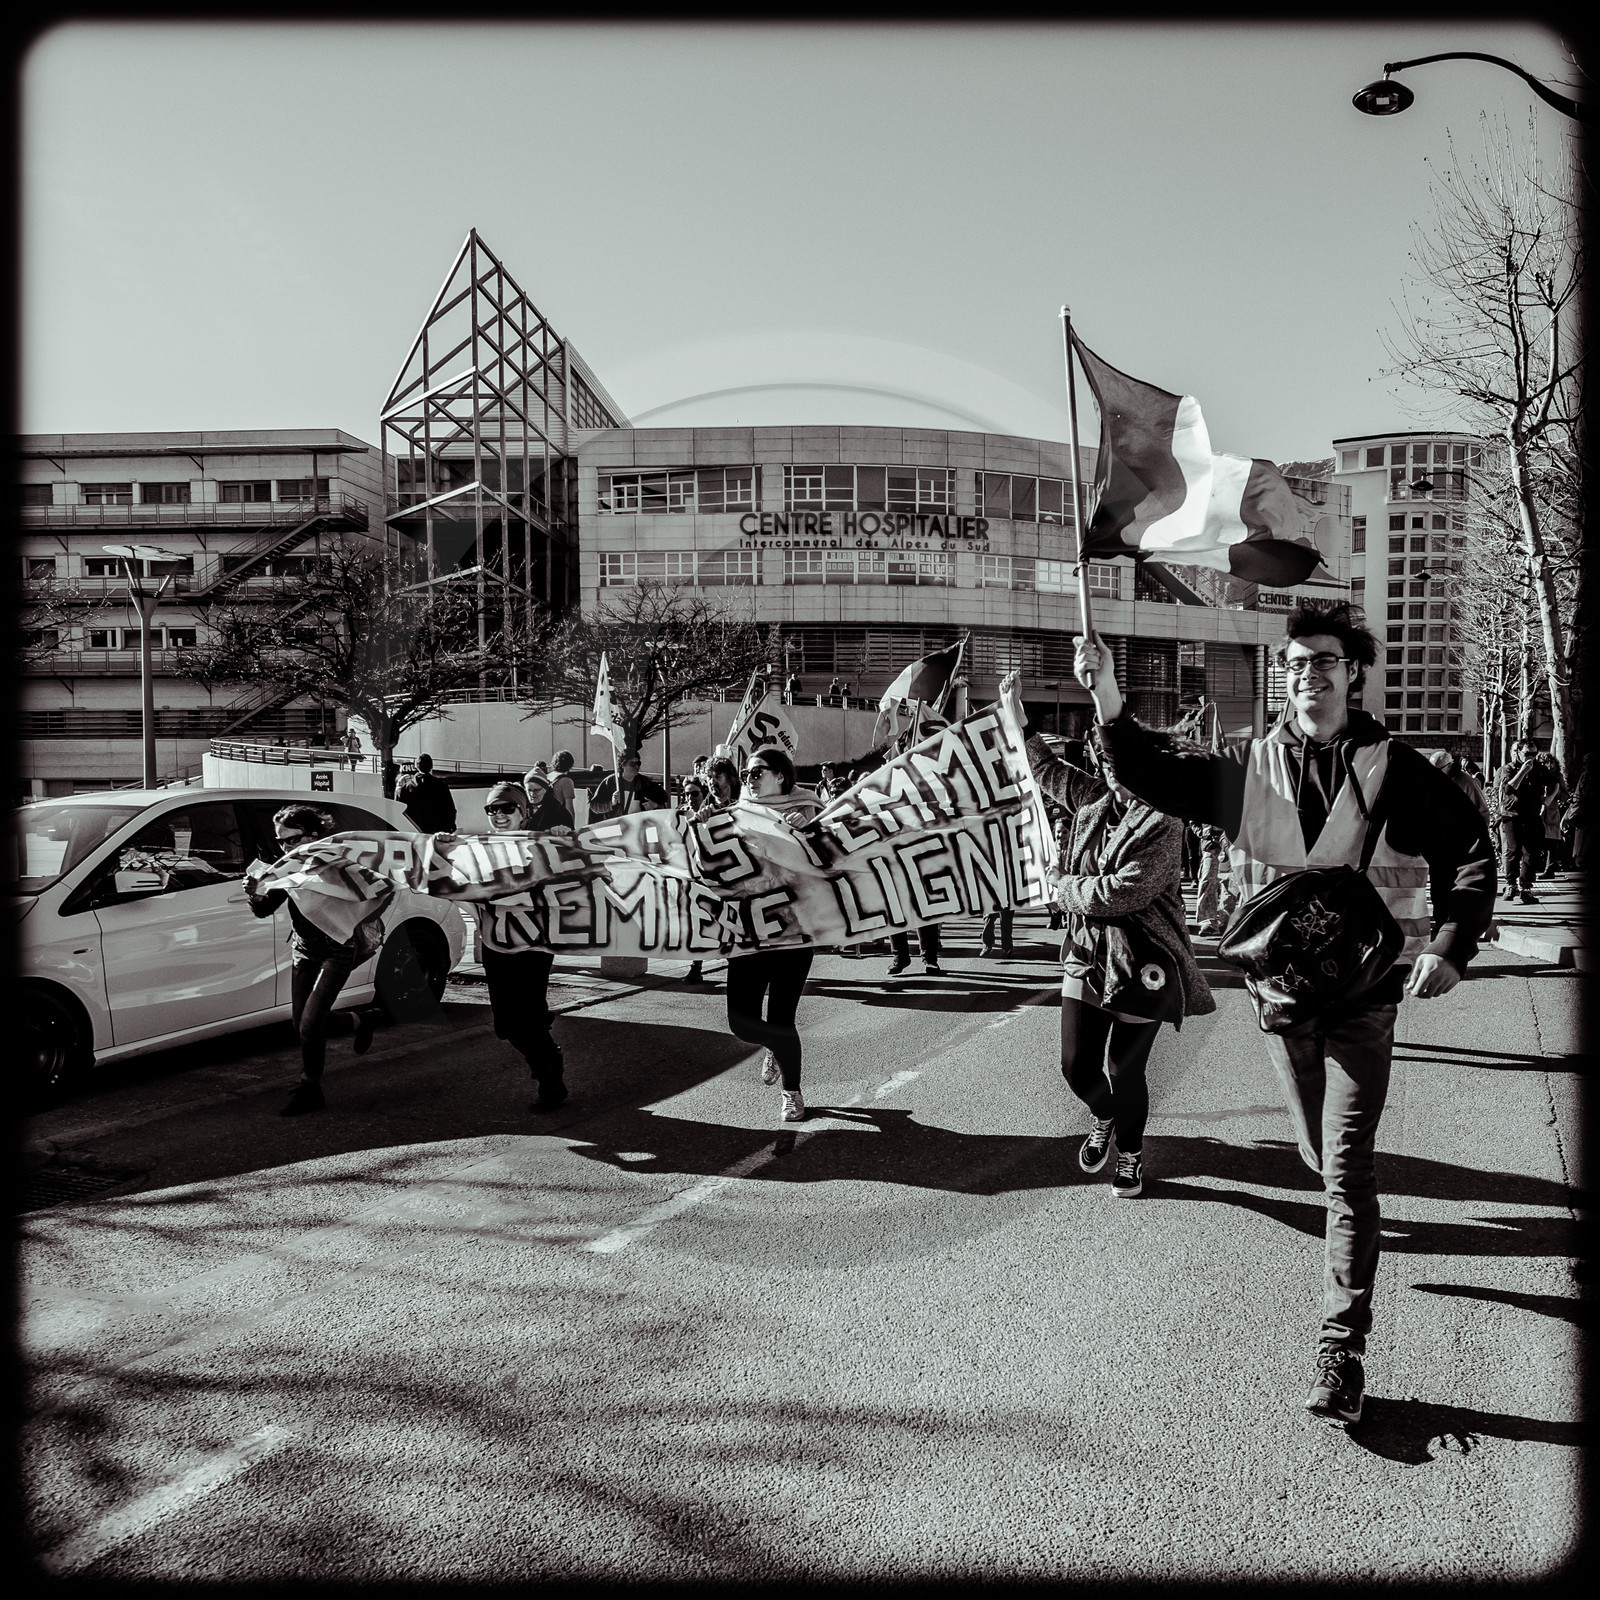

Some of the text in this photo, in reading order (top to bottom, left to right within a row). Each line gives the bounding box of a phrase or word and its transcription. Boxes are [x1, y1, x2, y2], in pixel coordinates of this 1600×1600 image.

[739, 512, 990, 540] CENTRE HOSPITALIER
[739, 537, 990, 553] Intercommunal des Alpes du Sud
[1258, 592, 1294, 607] CENTRE
